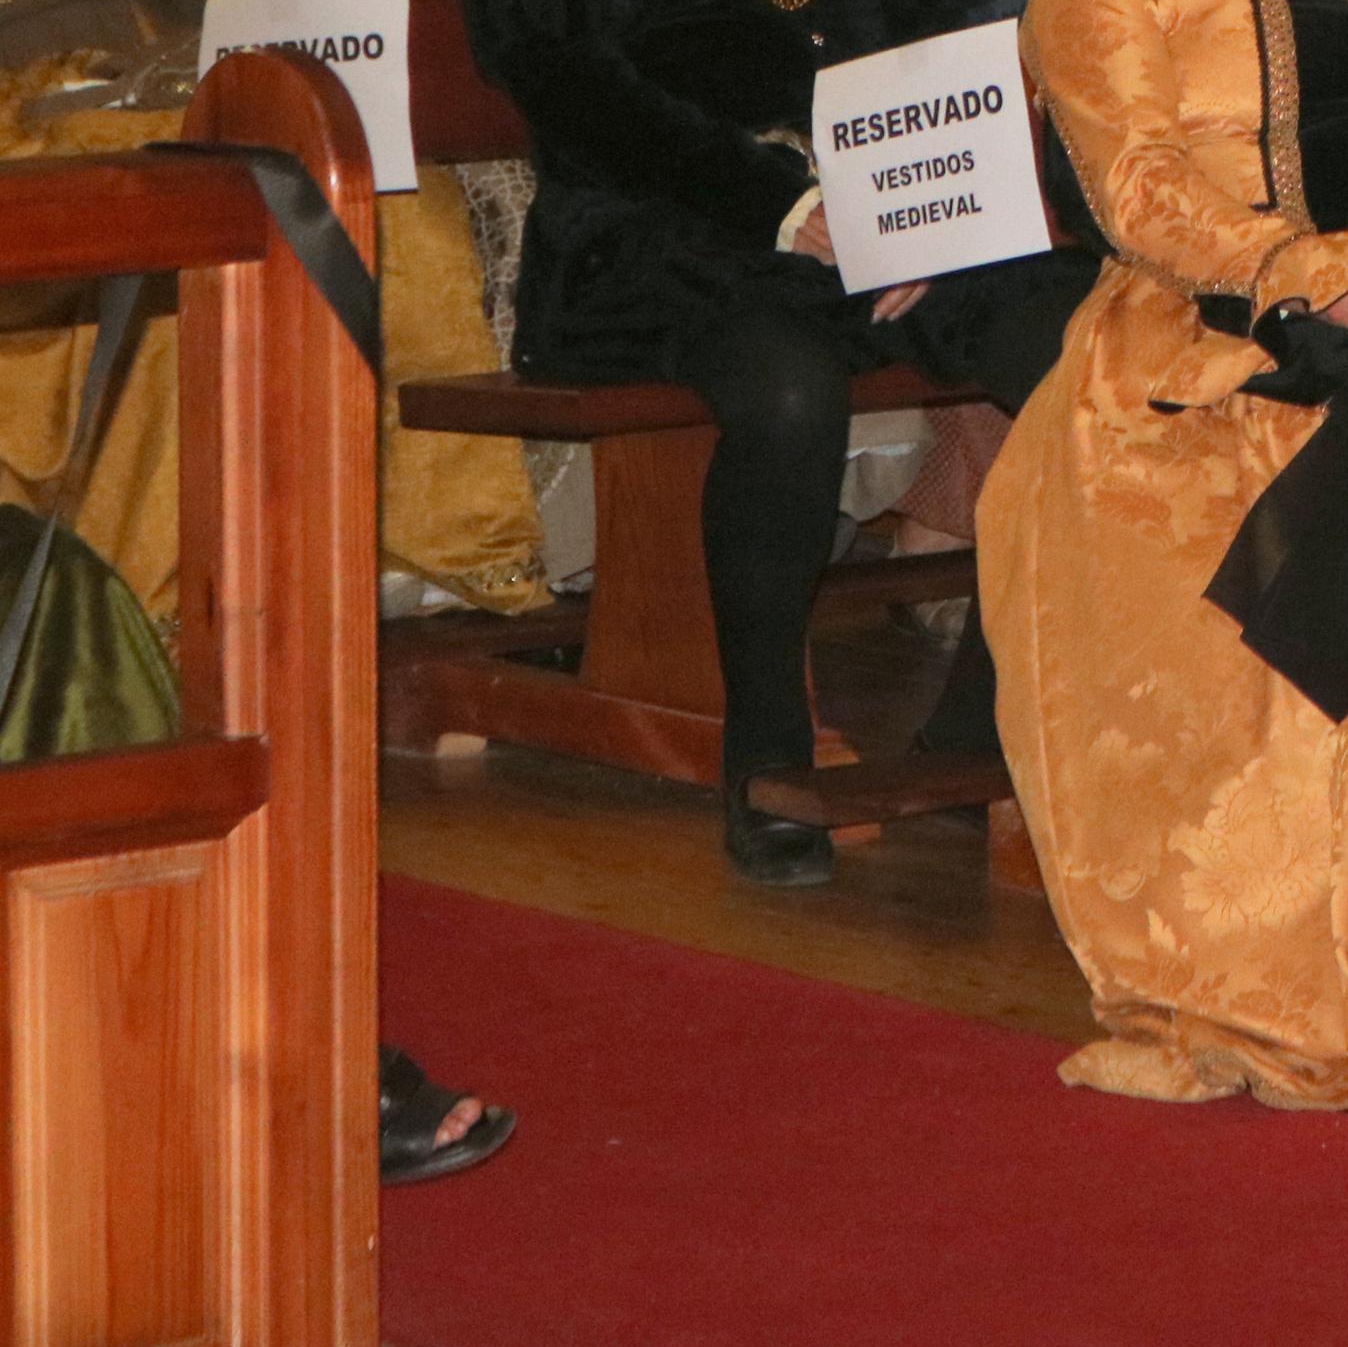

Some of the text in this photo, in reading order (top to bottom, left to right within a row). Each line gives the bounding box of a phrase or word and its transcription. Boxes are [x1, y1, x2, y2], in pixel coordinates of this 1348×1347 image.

[832, 84, 1003, 152] RESERVADO
[871, 150, 975, 192] VESTIDOS
[877, 193, 982, 235] MEDIEVAL
